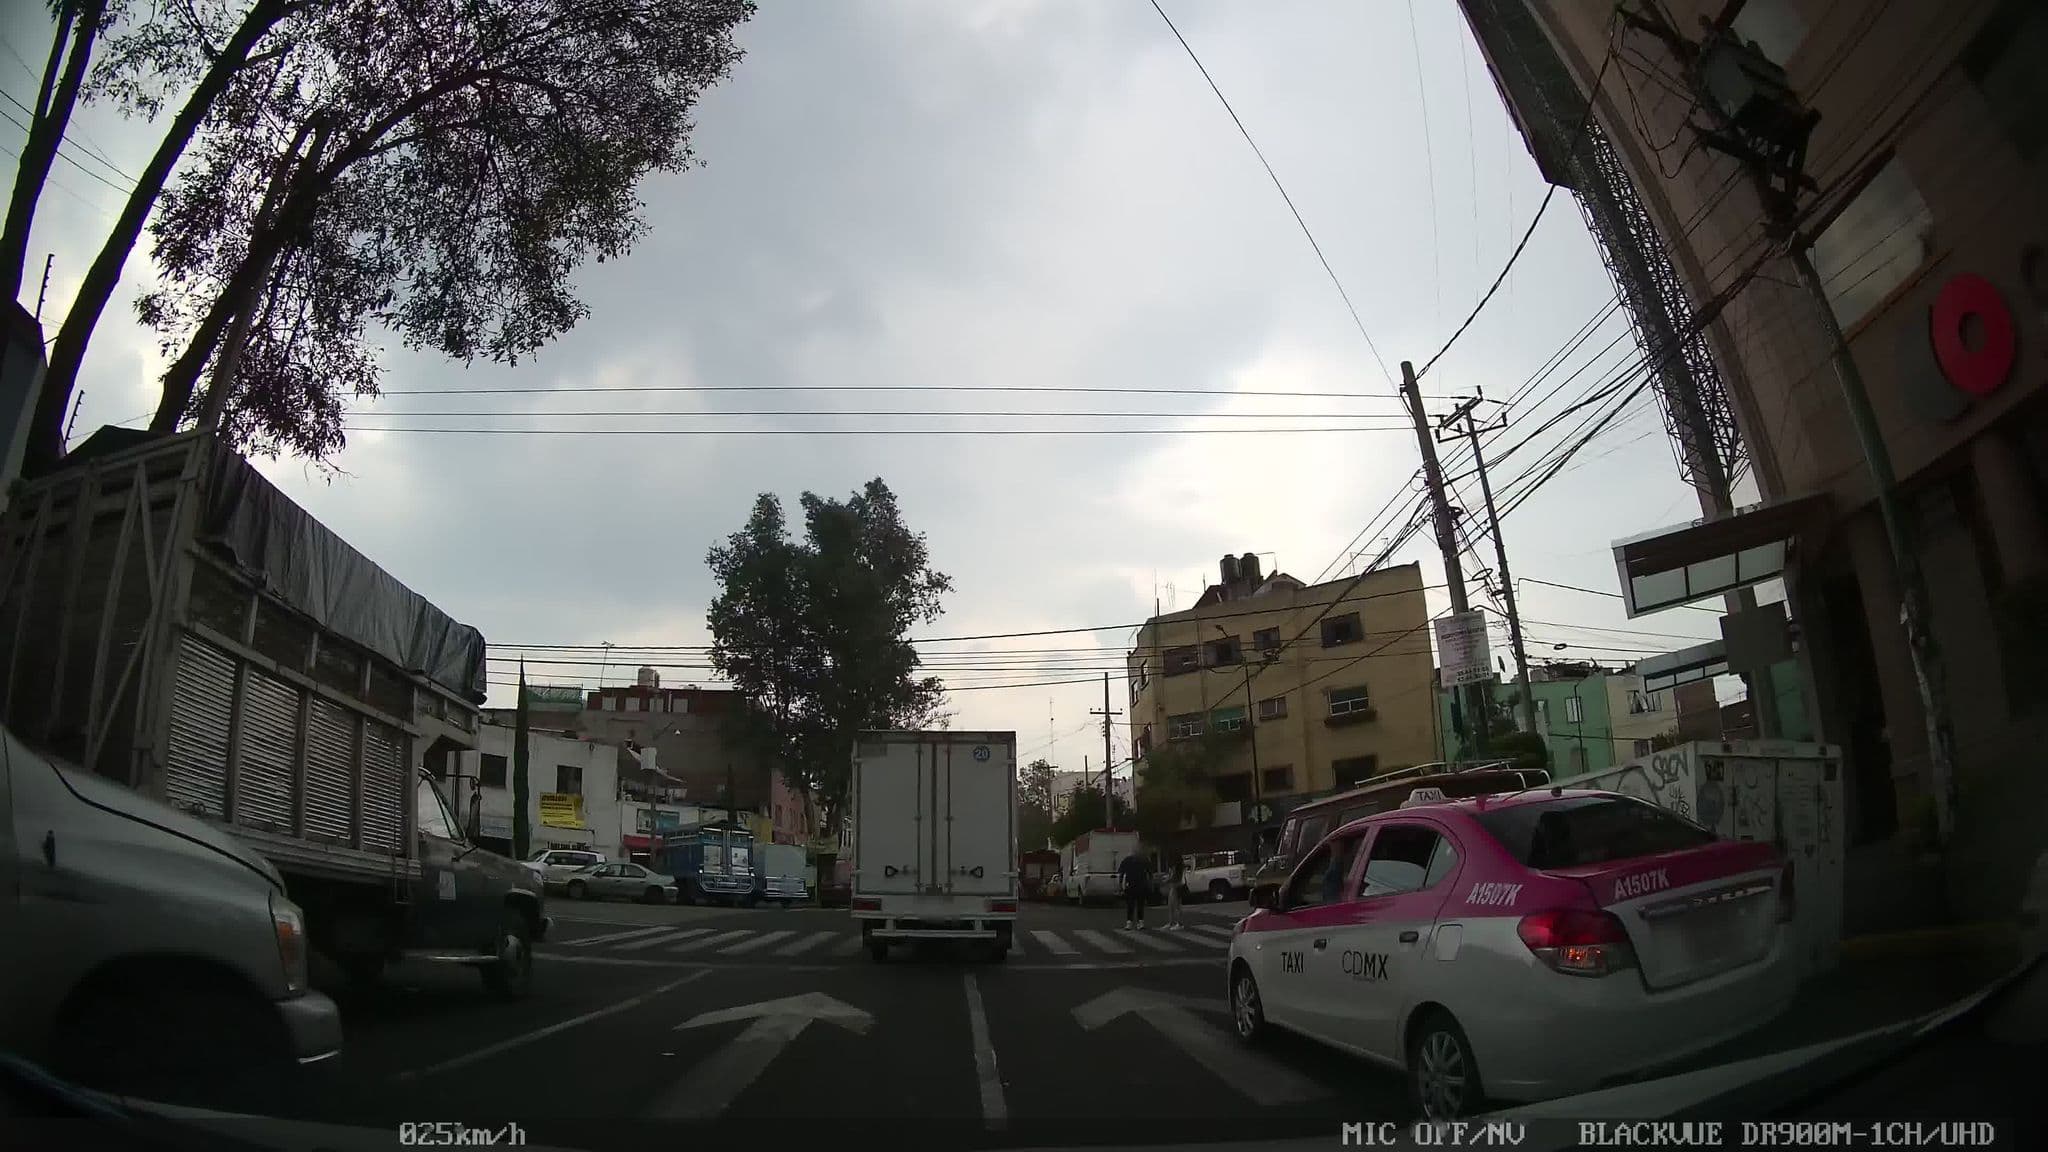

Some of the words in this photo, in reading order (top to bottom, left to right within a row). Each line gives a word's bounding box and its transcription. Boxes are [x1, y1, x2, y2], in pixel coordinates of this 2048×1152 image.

[1416, 791, 1441, 800] TAXI
[1466, 882, 1523, 906] A1507K
[1614, 867, 1670, 900] A1507K
[1281, 951, 1304, 973] TAXI
[1342, 950, 1389, 980] CDMX
